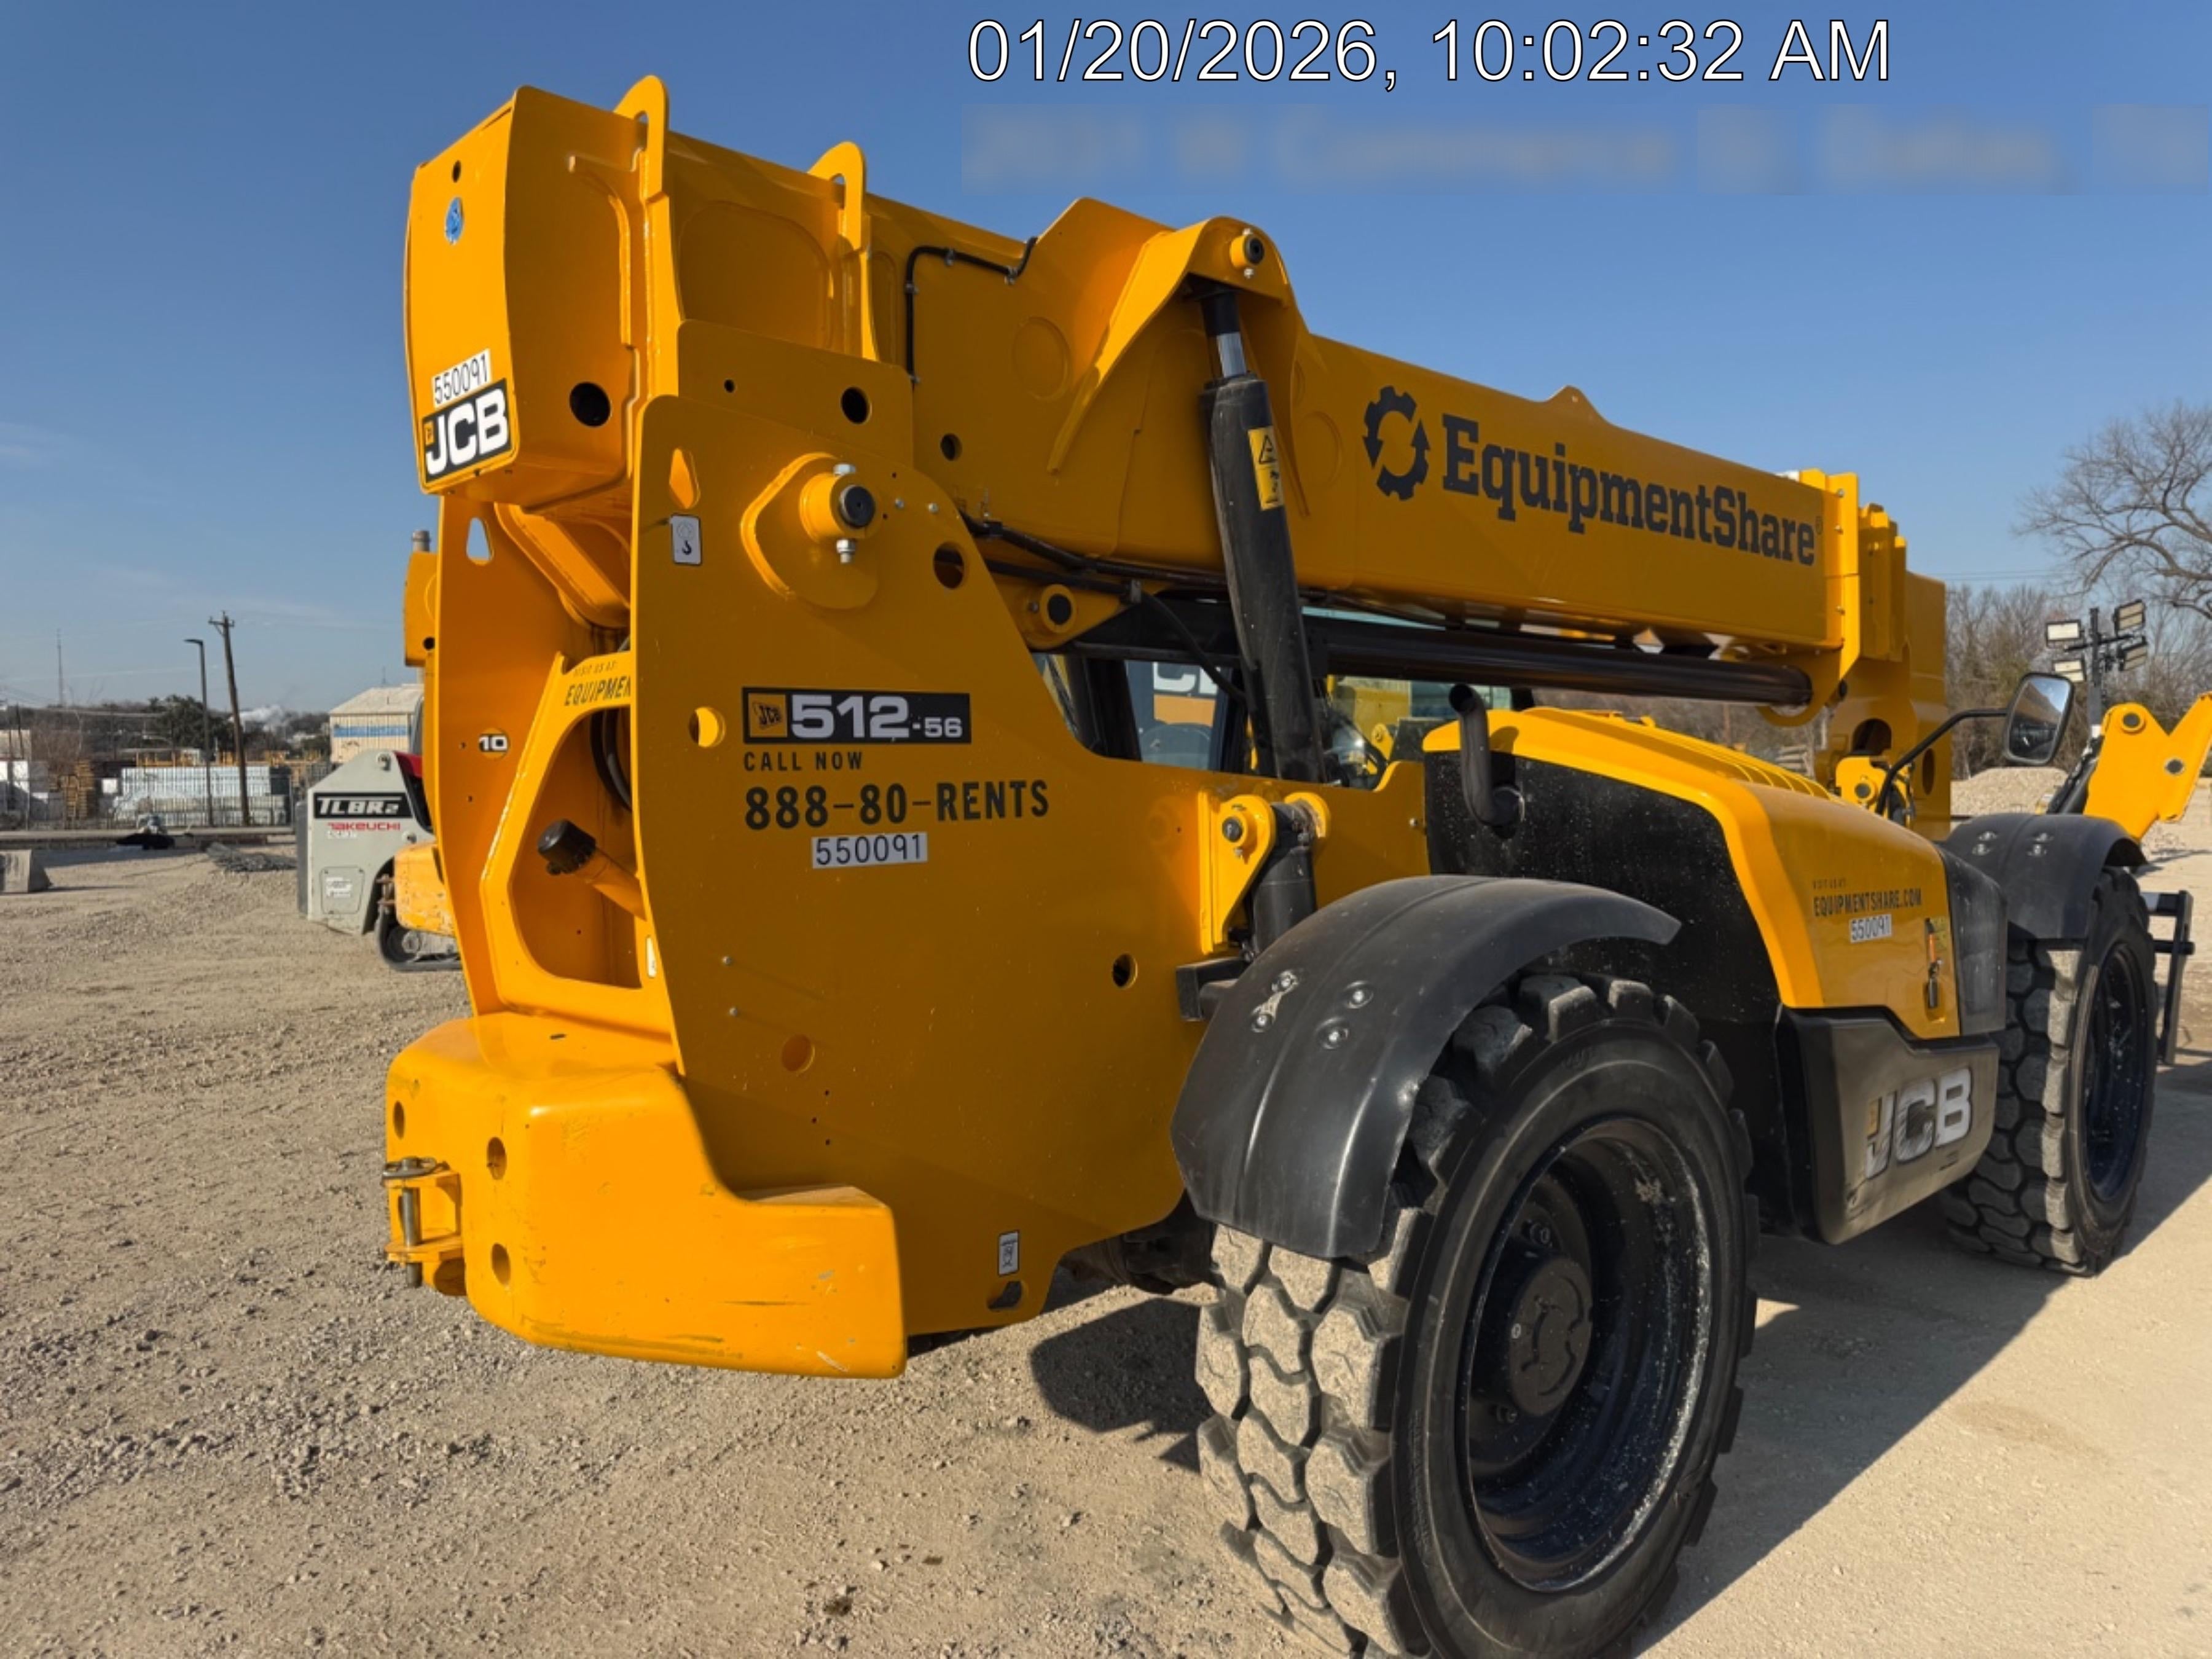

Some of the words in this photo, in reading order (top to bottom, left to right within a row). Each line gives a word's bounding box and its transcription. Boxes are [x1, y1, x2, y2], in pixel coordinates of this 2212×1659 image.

[434, 353, 488, 405] 550091
[425, 388, 509, 475] JCB
[1441, 413, 1816, 567] EquipmentShare
[743, 751, 802, 771] CALL
[815, 751, 863, 771] NOW
[745, 779, 1049, 831] 888-80-RENTS
[815, 834, 921, 866] 550091
[1814, 888, 1922, 917] EQUIPMENTSHARE.COM
[1851, 915, 1890, 941] 550091
[1864, 1067, 1972, 1180] JCB
